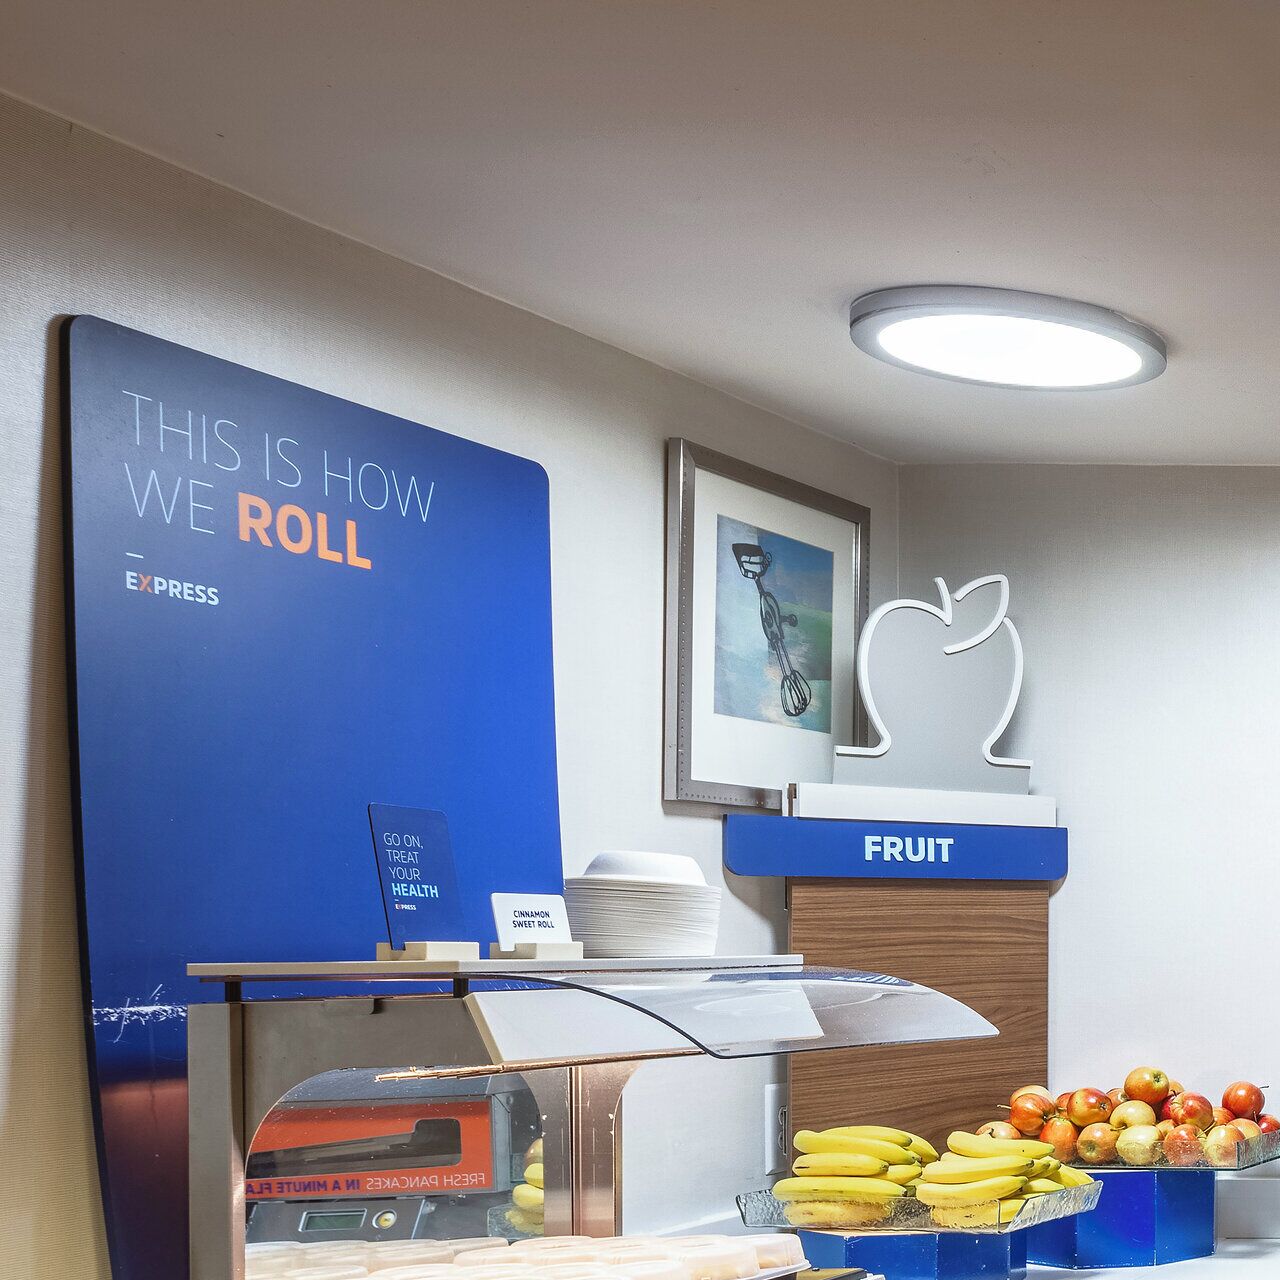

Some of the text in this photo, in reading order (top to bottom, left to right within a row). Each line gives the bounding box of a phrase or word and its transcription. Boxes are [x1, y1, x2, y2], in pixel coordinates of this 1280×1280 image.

[122, 390, 435, 523] THIS IS HOW
[124, 462, 372, 570] WE ROLL
[125, 570, 220, 606] EXPRESS
[383, 832, 424, 850] GO ON,
[864, 835, 955, 863] FRUIT
[385, 849, 419, 864] TREAT
[388, 866, 421, 881] YOUR
[391, 882, 439, 898] HEALTH
[513, 910, 550, 918] CINNAMON
[512, 920, 555, 928] SWEET ROLL
